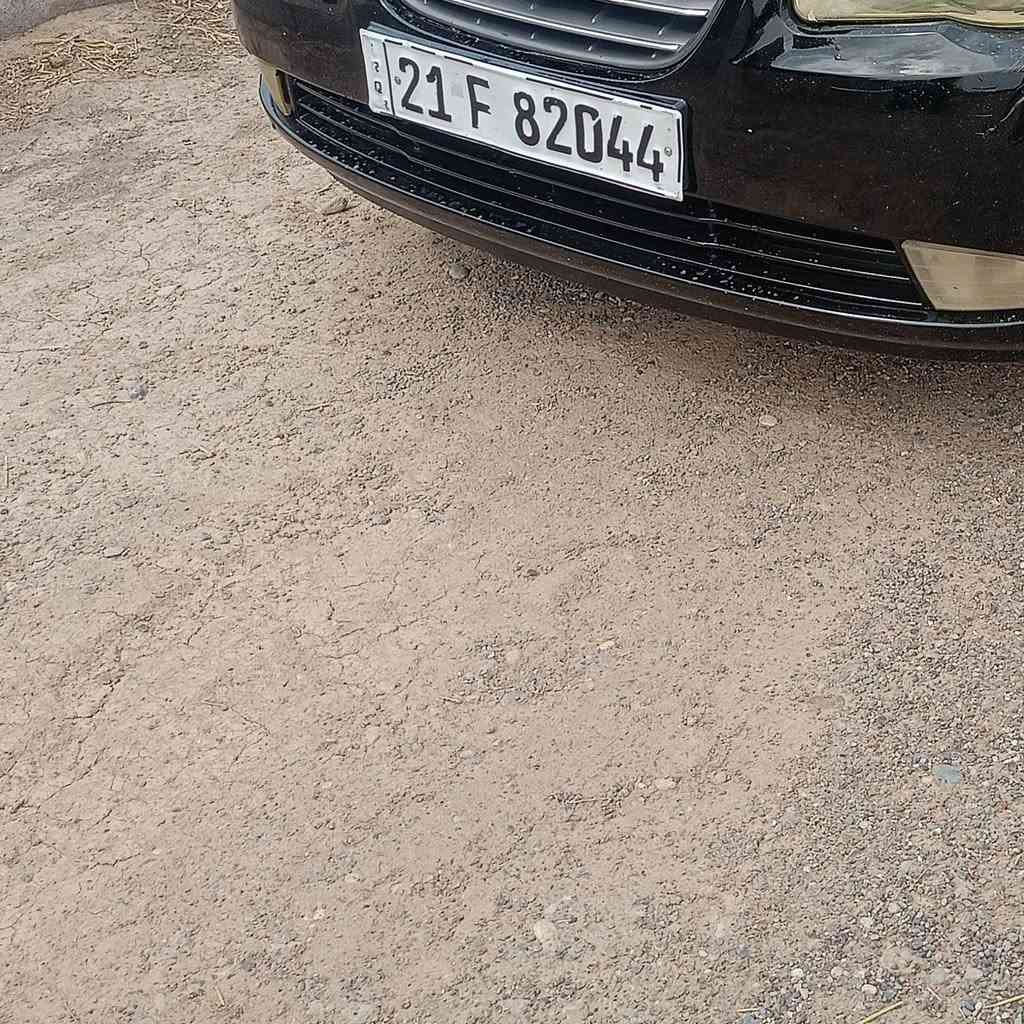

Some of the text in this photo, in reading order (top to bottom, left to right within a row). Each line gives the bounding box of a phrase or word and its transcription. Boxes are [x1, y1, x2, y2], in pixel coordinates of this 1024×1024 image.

[398, 57, 664, 183] 21 F 82044
